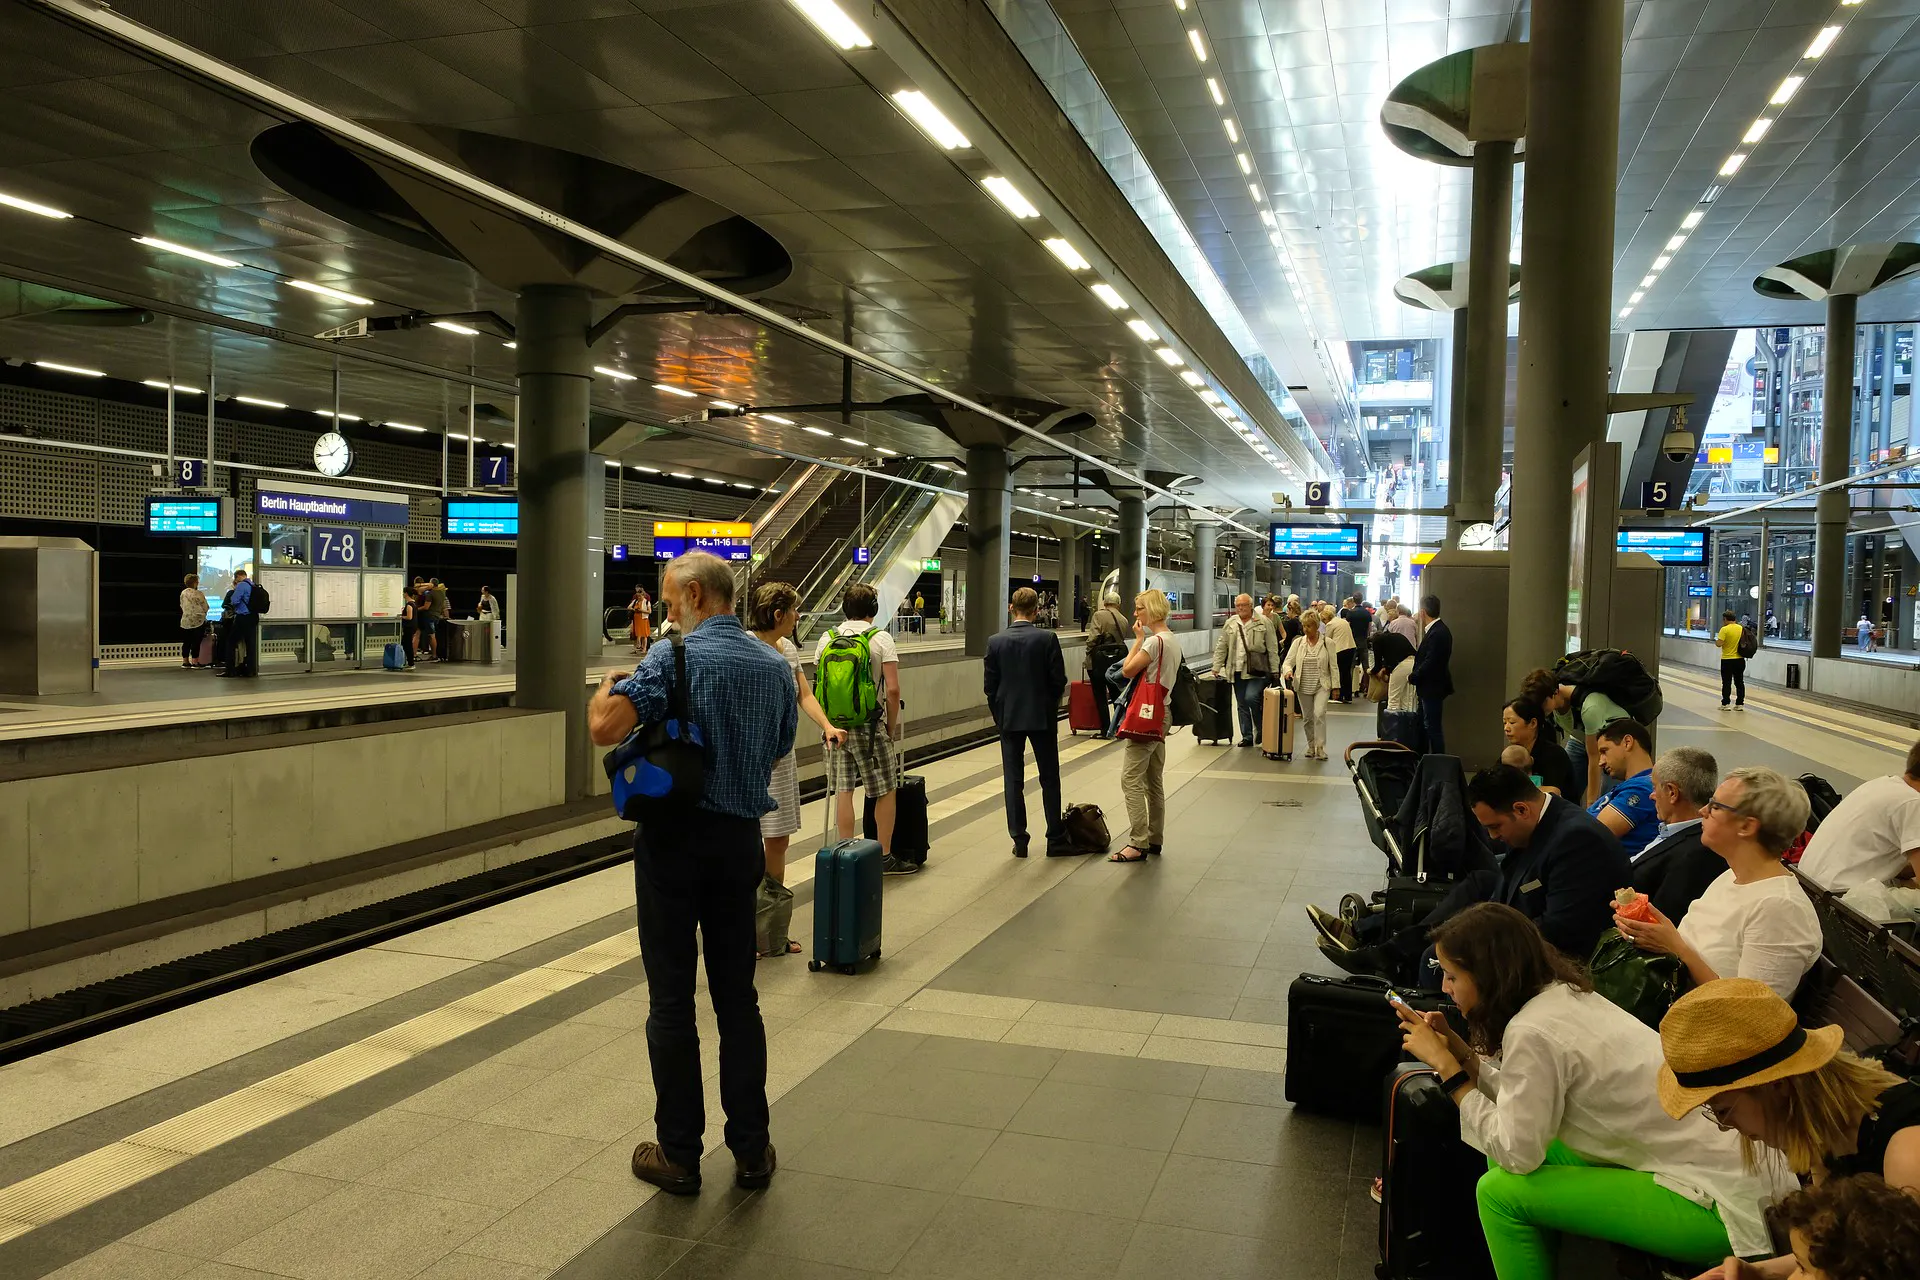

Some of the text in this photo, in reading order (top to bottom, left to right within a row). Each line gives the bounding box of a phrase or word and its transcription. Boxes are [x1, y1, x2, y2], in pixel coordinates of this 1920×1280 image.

[1738, 443, 1756, 454] 1-2
[182, 460, 193, 481] 8
[490, 457, 502, 479] 7
[1308, 481, 1322, 501] 6
[1652, 482, 1667, 502] 5
[261, 495, 347, 515] Berlin Hauptbahnhof
[319, 533, 355, 563] 7-8
[695, 538, 708, 546] 1-6
[713, 538, 731, 546] 11-16
[613, 545, 622, 558] E
[858, 547, 868, 562] E
[1326, 560, 1336, 572] E
[1032, 574, 1039, 582] D
[1804, 583, 1813, 593] D
